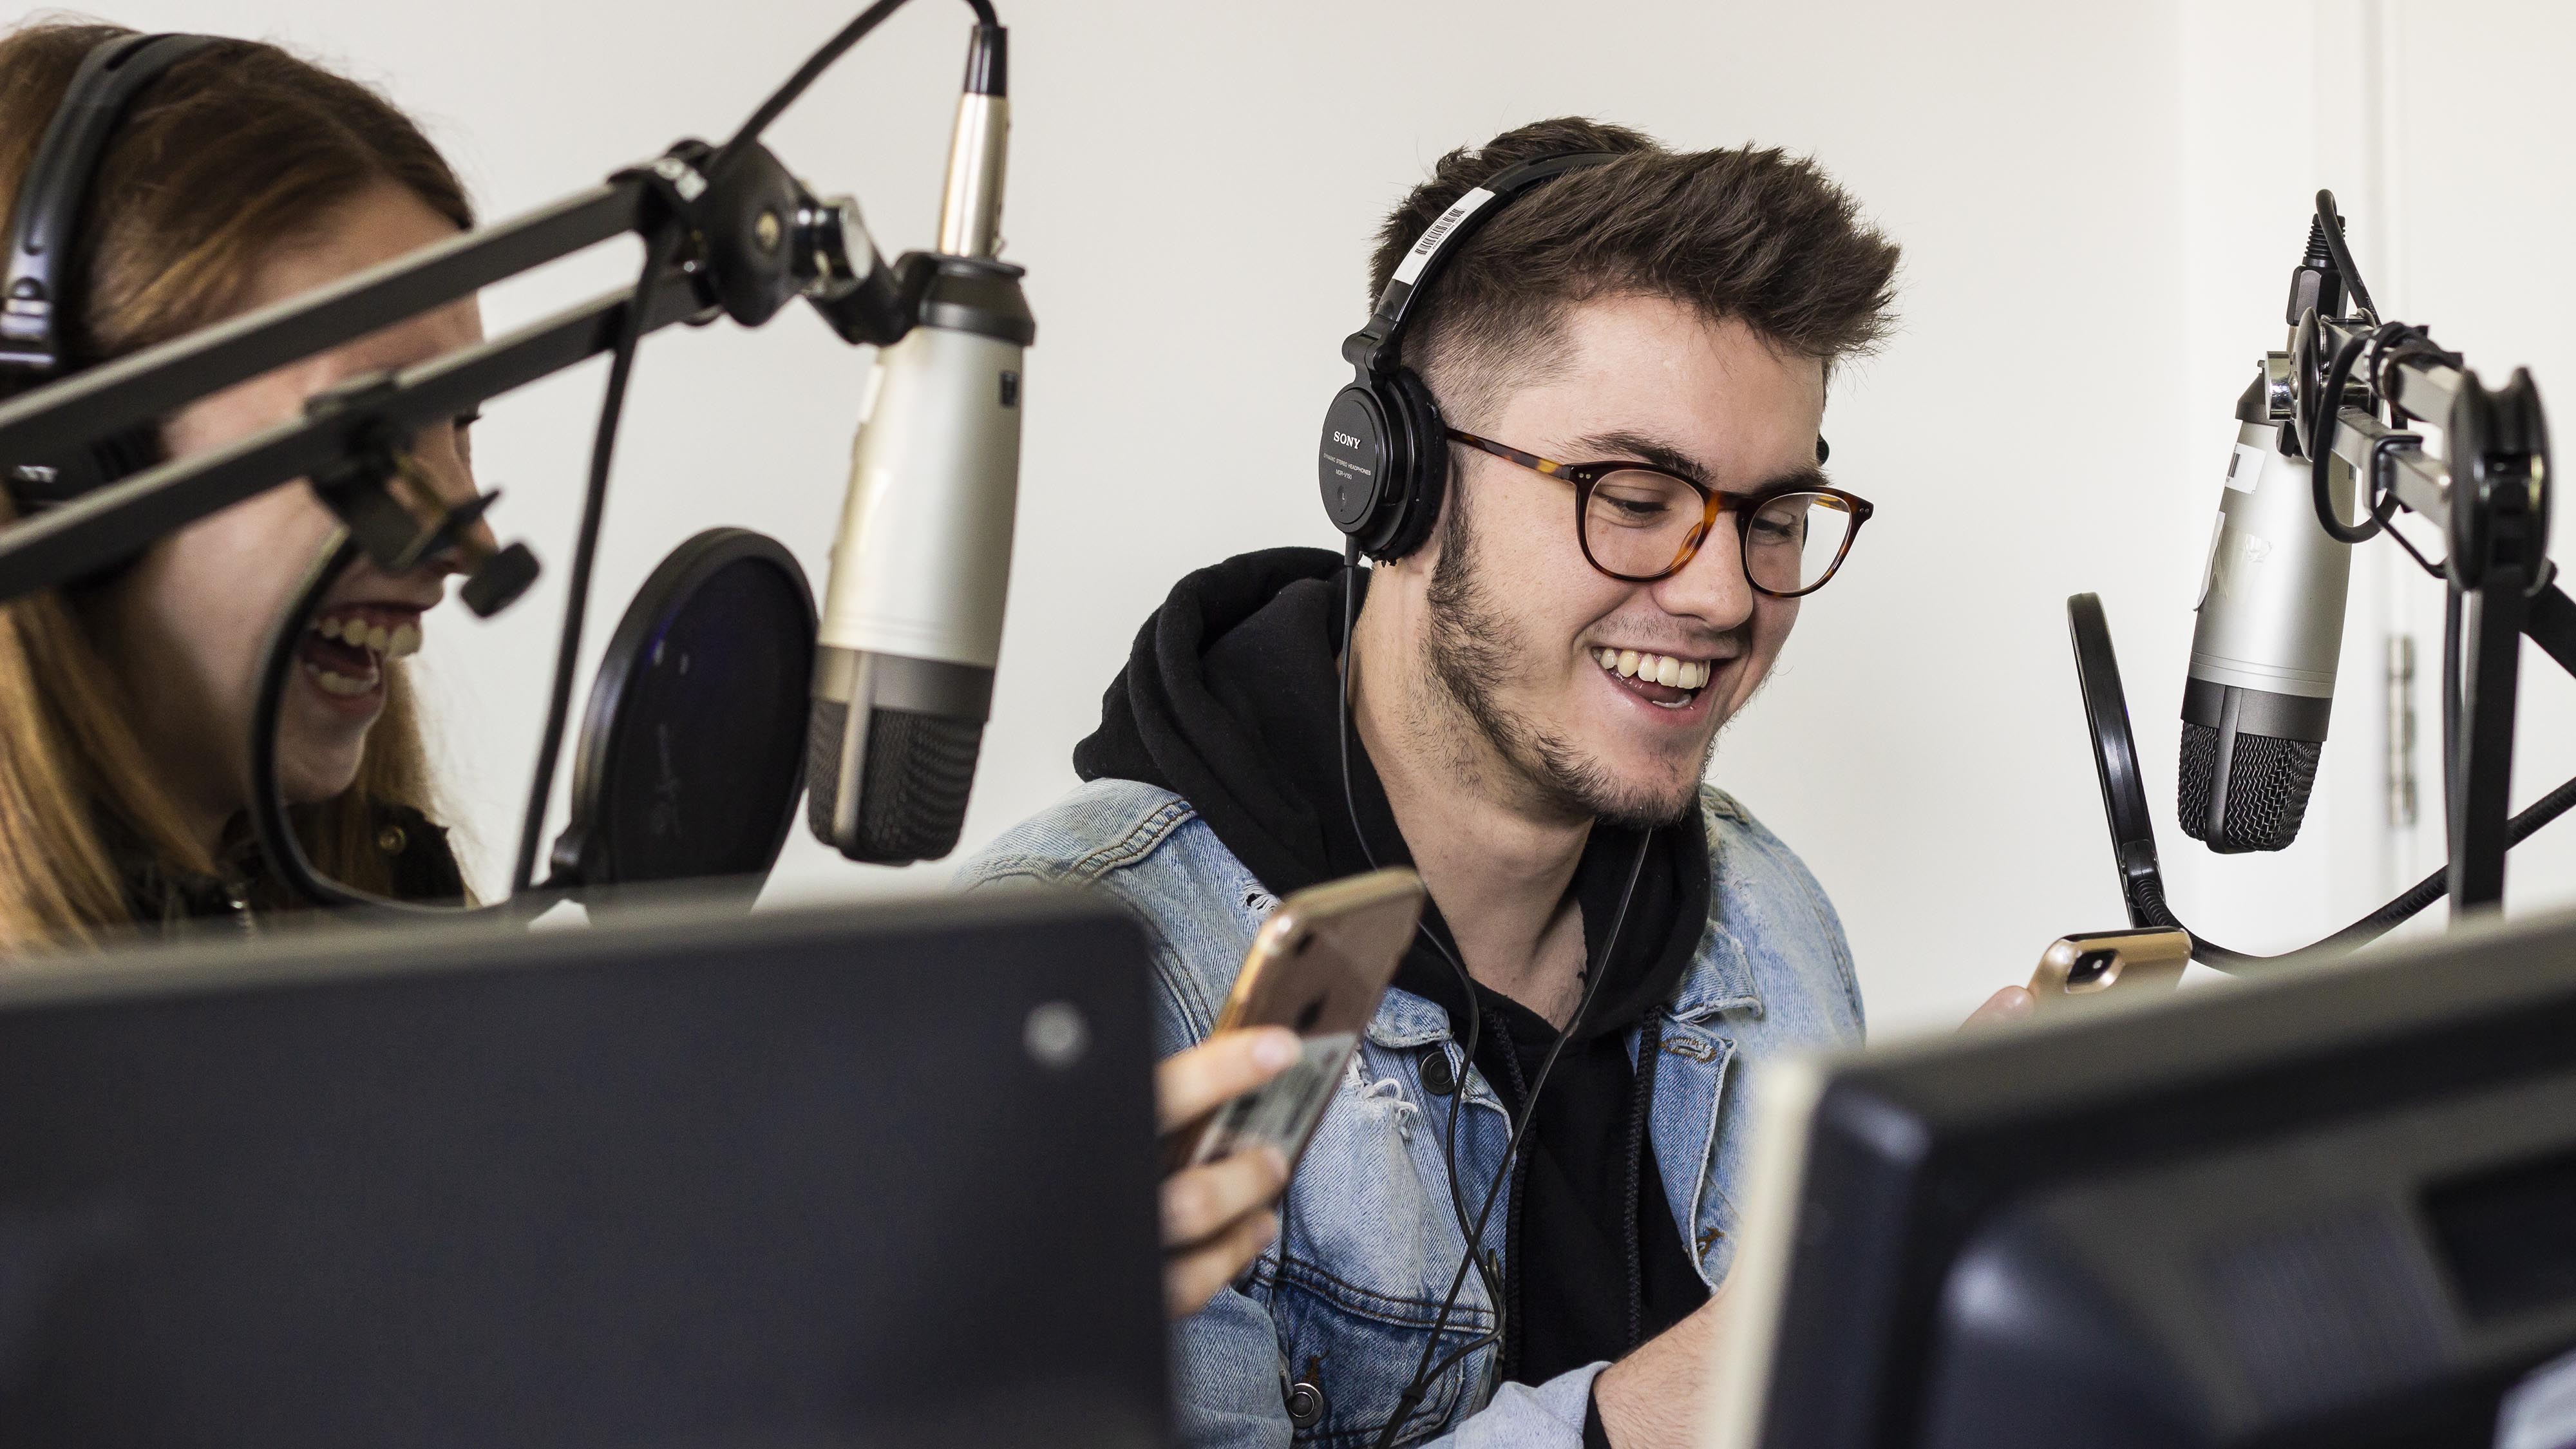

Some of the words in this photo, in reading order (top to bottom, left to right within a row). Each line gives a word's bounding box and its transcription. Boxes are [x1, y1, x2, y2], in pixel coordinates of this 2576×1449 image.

[1333, 431, 1361, 450] SONY
[1336, 458, 1348, 468] STEREO
[1348, 463, 1371, 476] HEADPHONES
[1335, 469, 1352, 480] MDR-V150
[1342, 492, 1345, 500] L
